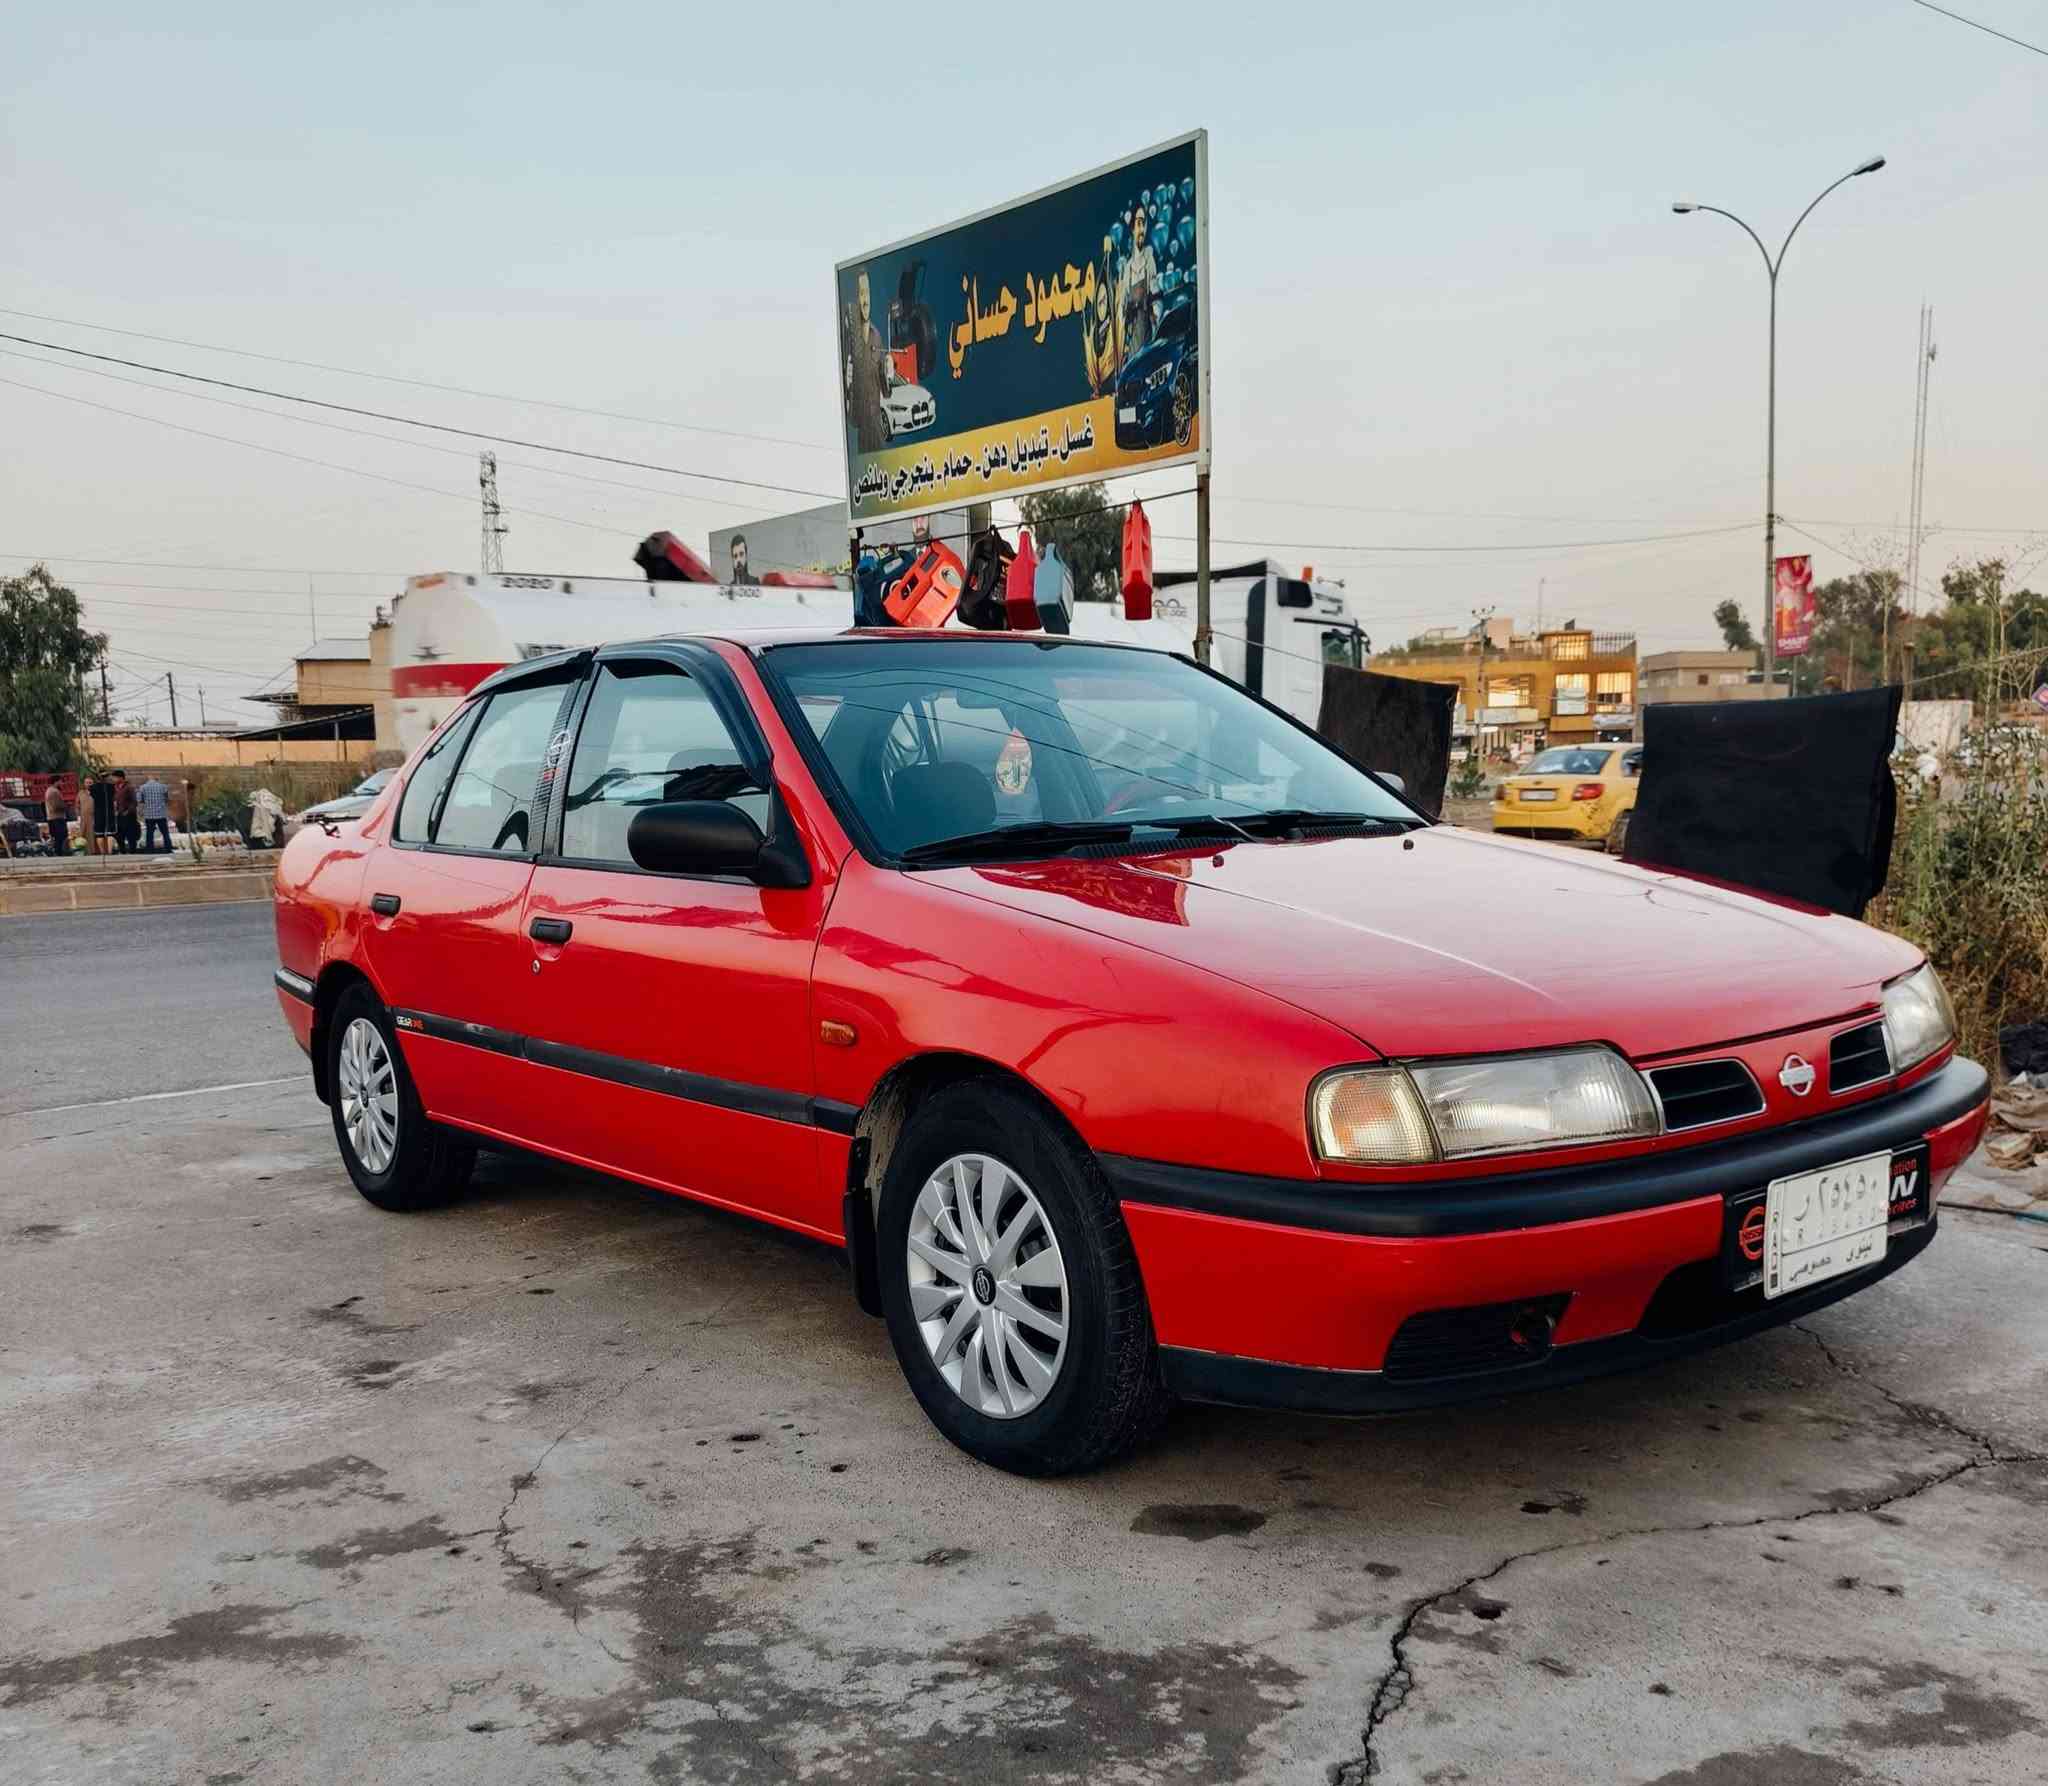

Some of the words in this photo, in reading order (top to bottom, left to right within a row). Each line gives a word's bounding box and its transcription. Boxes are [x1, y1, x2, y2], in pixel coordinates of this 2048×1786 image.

[1023, 260, 1096, 344] محمود
[948, 273, 1018, 380] حساني
[982, 443, 1008, 480] دهن
[1010, 427, 1049, 473] تبديل
[1059, 415, 1095, 463] غسل
[943, 450, 972, 487] حمام
[1889, 1170, 1918, 1201] N
